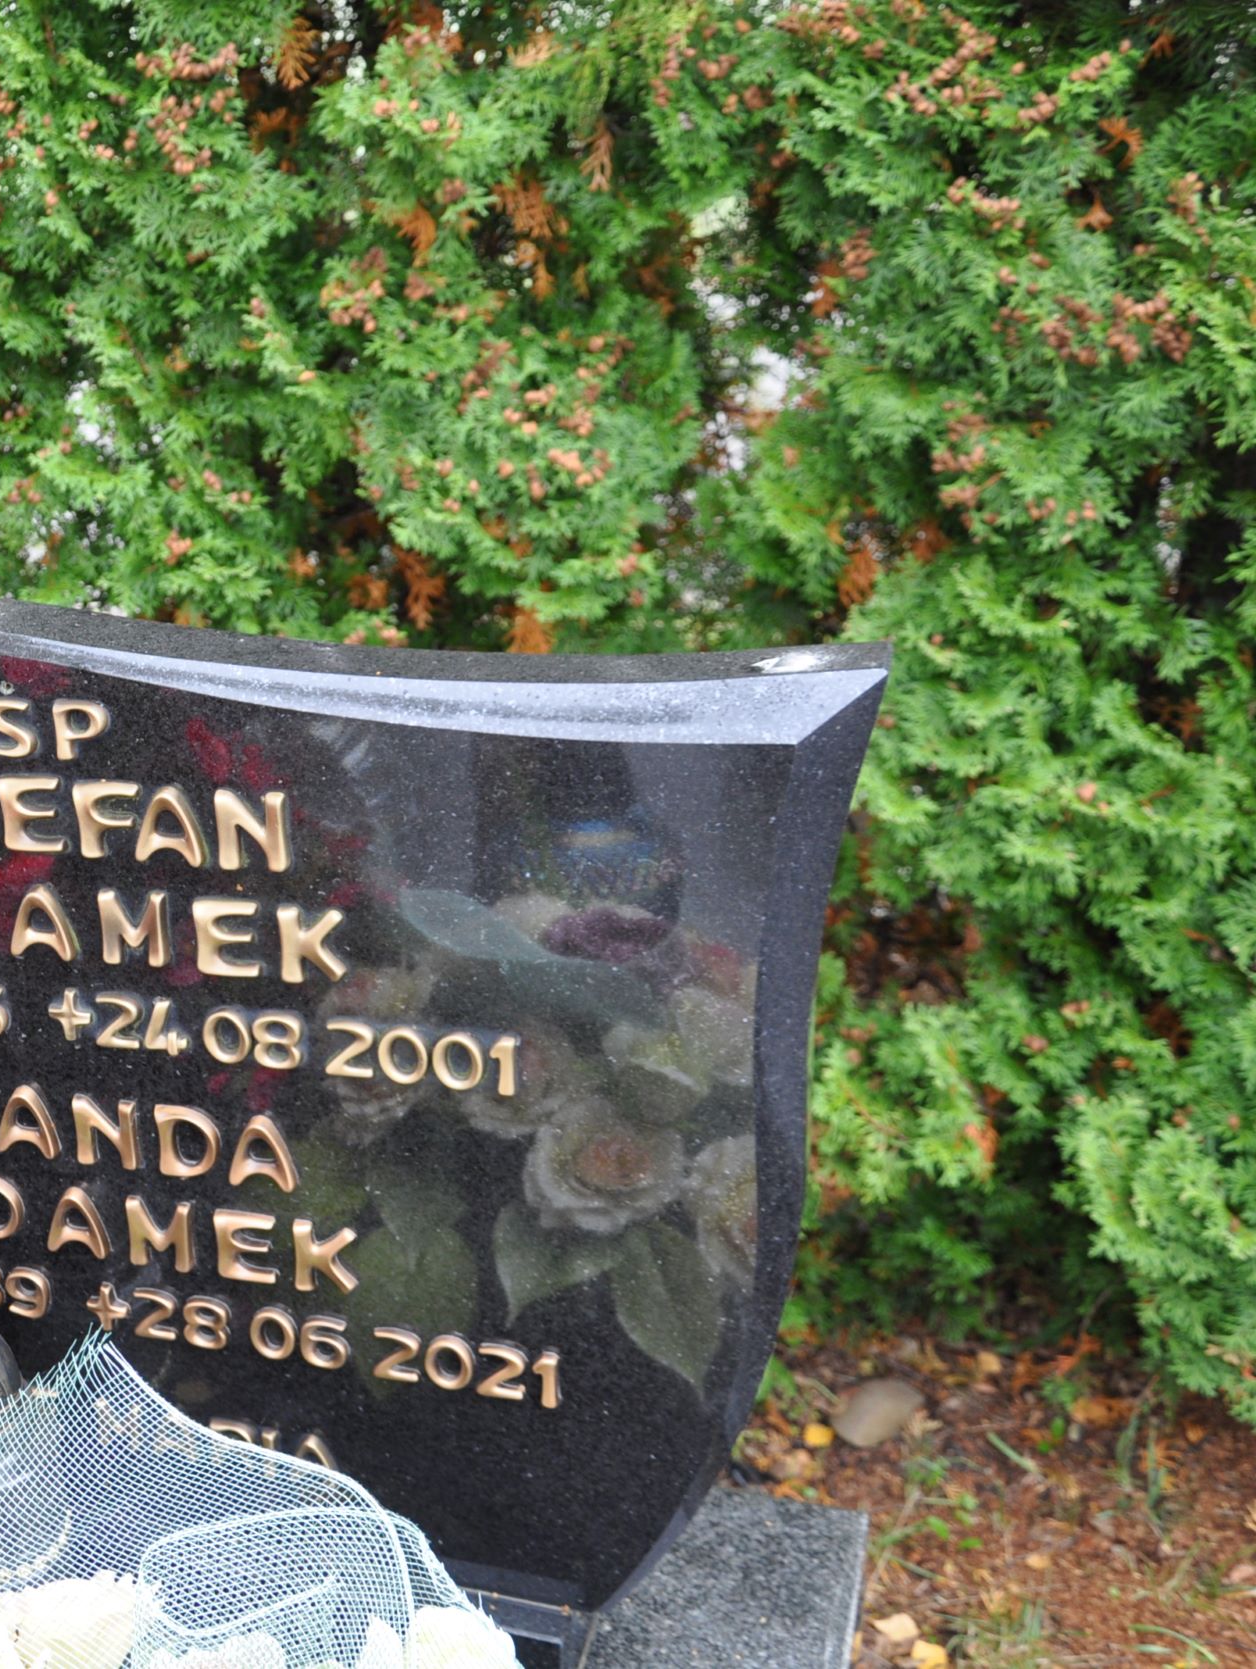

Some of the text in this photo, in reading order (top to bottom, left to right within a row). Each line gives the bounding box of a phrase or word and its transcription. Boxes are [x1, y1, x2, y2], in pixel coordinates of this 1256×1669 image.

[202, 1008, 303, 1069] 08
[325, 1018, 518, 1096] 2001
[249, 1306, 349, 1370] 06
[373, 1326, 560, 1408] 2021
